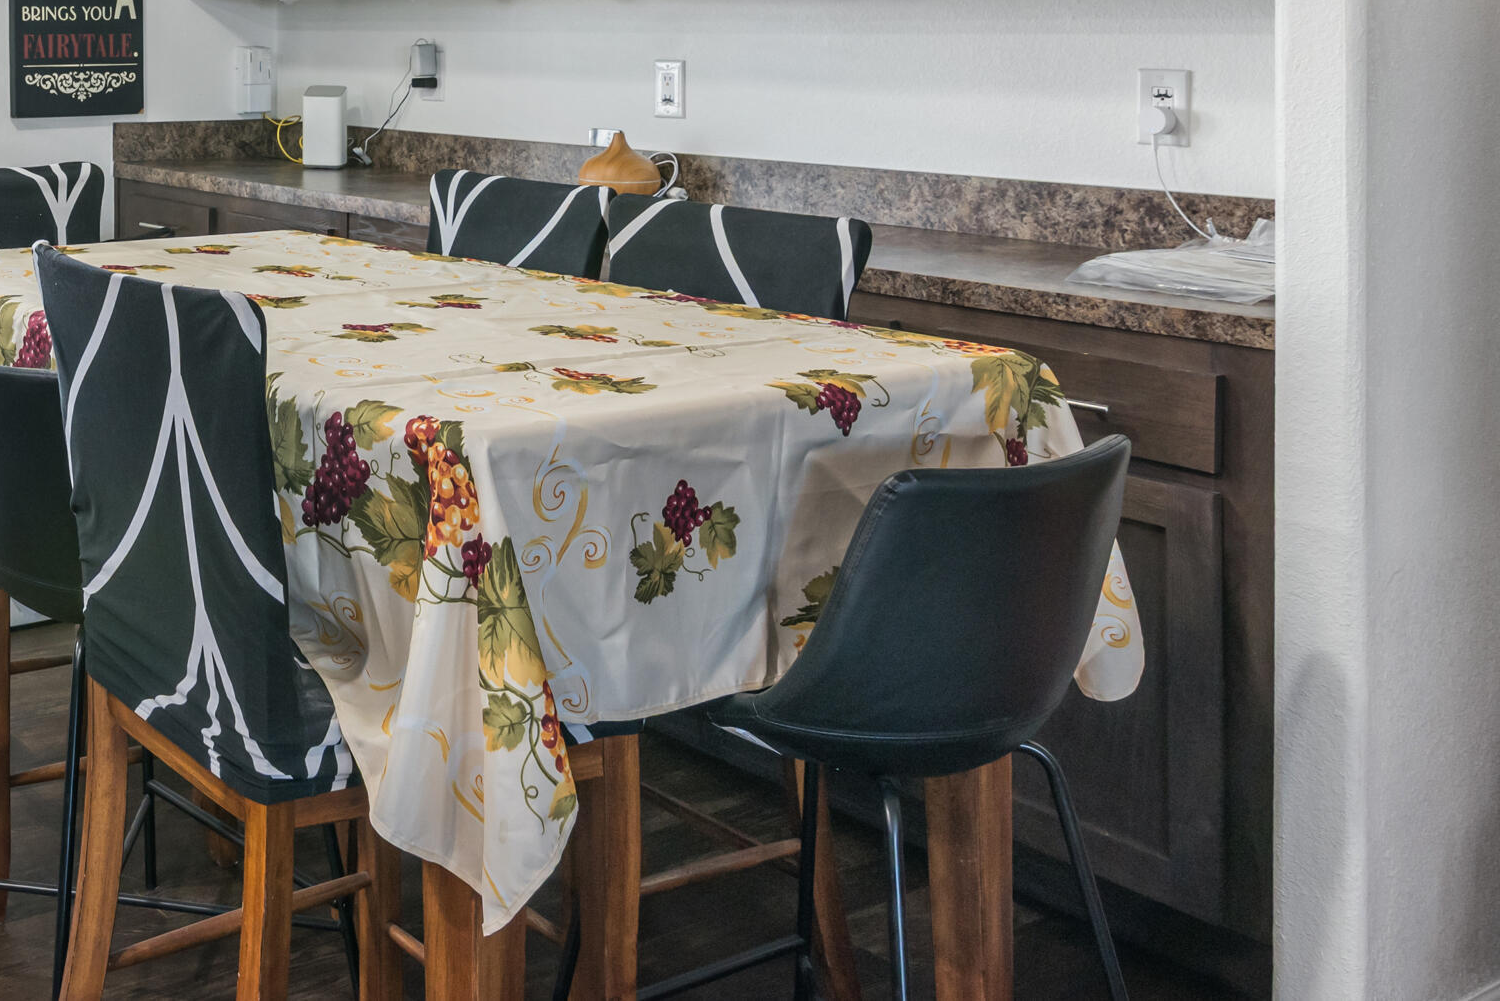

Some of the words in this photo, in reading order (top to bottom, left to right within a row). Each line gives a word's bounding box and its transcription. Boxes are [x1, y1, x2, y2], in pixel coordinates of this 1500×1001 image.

[22, 5, 77, 22] BRINGS
[82, 5, 113, 21] YOU
[23, 33, 138, 59] FAIRYTALE.
